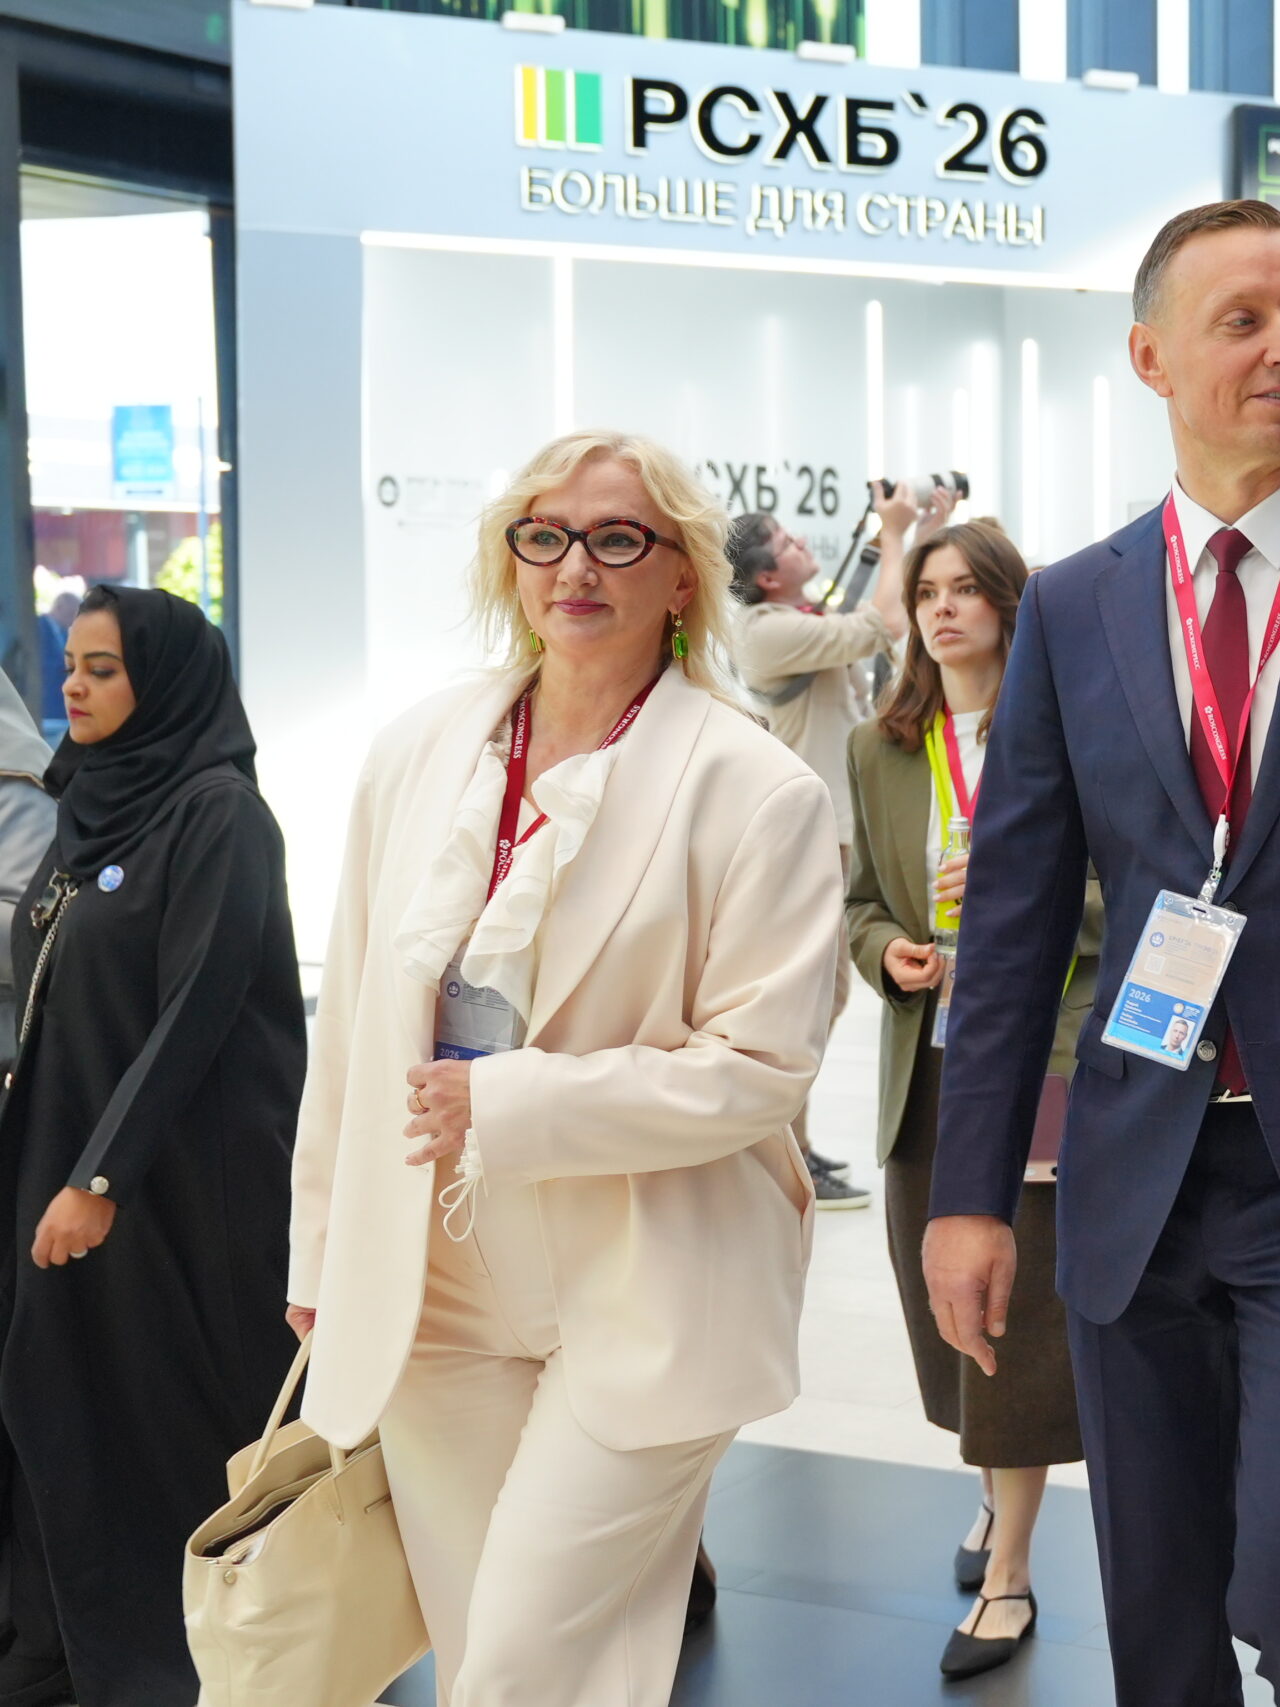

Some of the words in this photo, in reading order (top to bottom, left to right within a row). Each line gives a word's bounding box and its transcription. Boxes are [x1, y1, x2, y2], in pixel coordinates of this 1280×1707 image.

[520, 166, 737, 227] БОЛЬШЕ
[746, 180, 845, 237] ДЛЯ
[856, 193, 1045, 248] СТРАНЫ
[1172, 541, 1185, 584] ROSCONGRESS
[1208, 713, 1227, 760] ROSCONGRESS
[1129, 989, 1151, 1003] 2026
